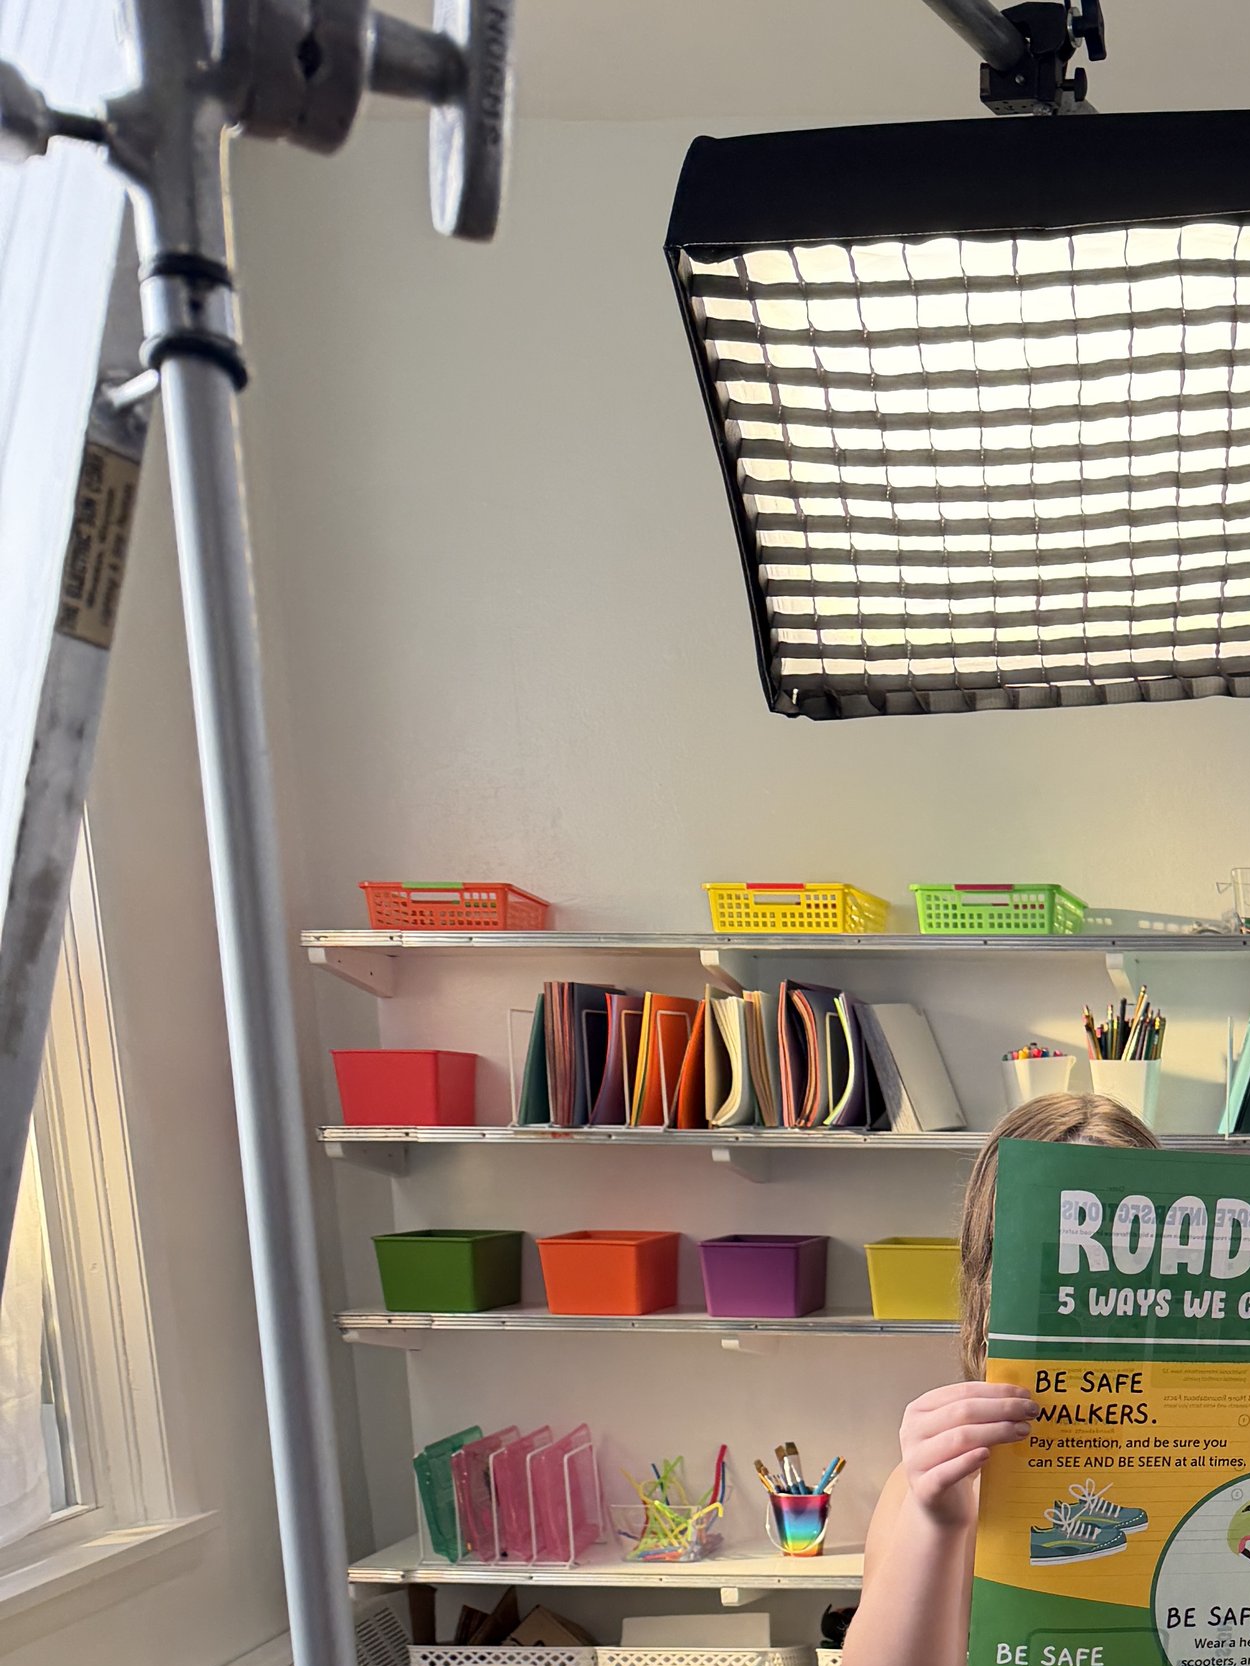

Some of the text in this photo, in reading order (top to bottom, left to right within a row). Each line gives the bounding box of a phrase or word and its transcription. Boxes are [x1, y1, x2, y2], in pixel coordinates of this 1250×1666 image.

[1058, 1286, 1075, 1315] 5
[1088, 1288, 1171, 1318] WAYS
[1183, 1290, 1227, 1319] WE
[1036, 1370, 1068, 1393] BE
[1080, 1371, 1143, 1393] SAFE
[1036, 1403, 1157, 1424] WALKERS.
[1030, 1437, 1227, 1450] Pay attention, and be sure you
[1028, 1456, 1247, 1468] can SEE AND BE SEEN at all times.
[1166, 1607, 1196, 1629] BE
[1194, 1637, 1226, 1649] Wear
[996, 1643, 1104, 1666] BE SAFE
